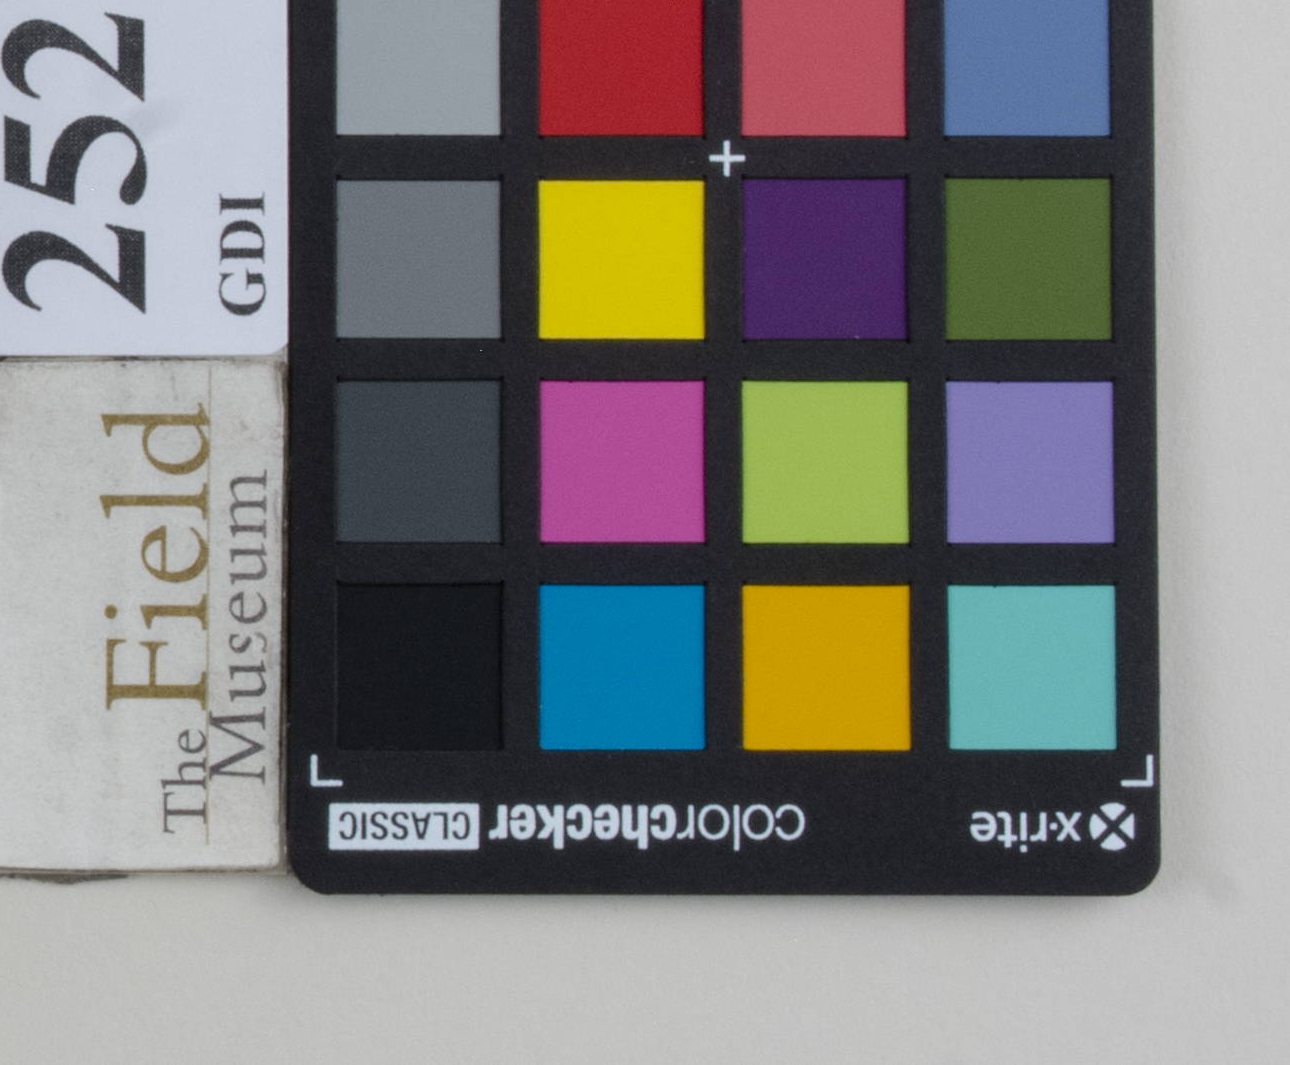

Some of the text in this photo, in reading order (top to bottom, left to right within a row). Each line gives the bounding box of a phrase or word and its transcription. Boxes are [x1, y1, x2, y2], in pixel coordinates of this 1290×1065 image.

[217, 191, 267, 317] GDI
[99, 402, 211, 834] The Field
[208, 469, 269, 786] Museum
[339, 810, 471, 840] CLASSIC
